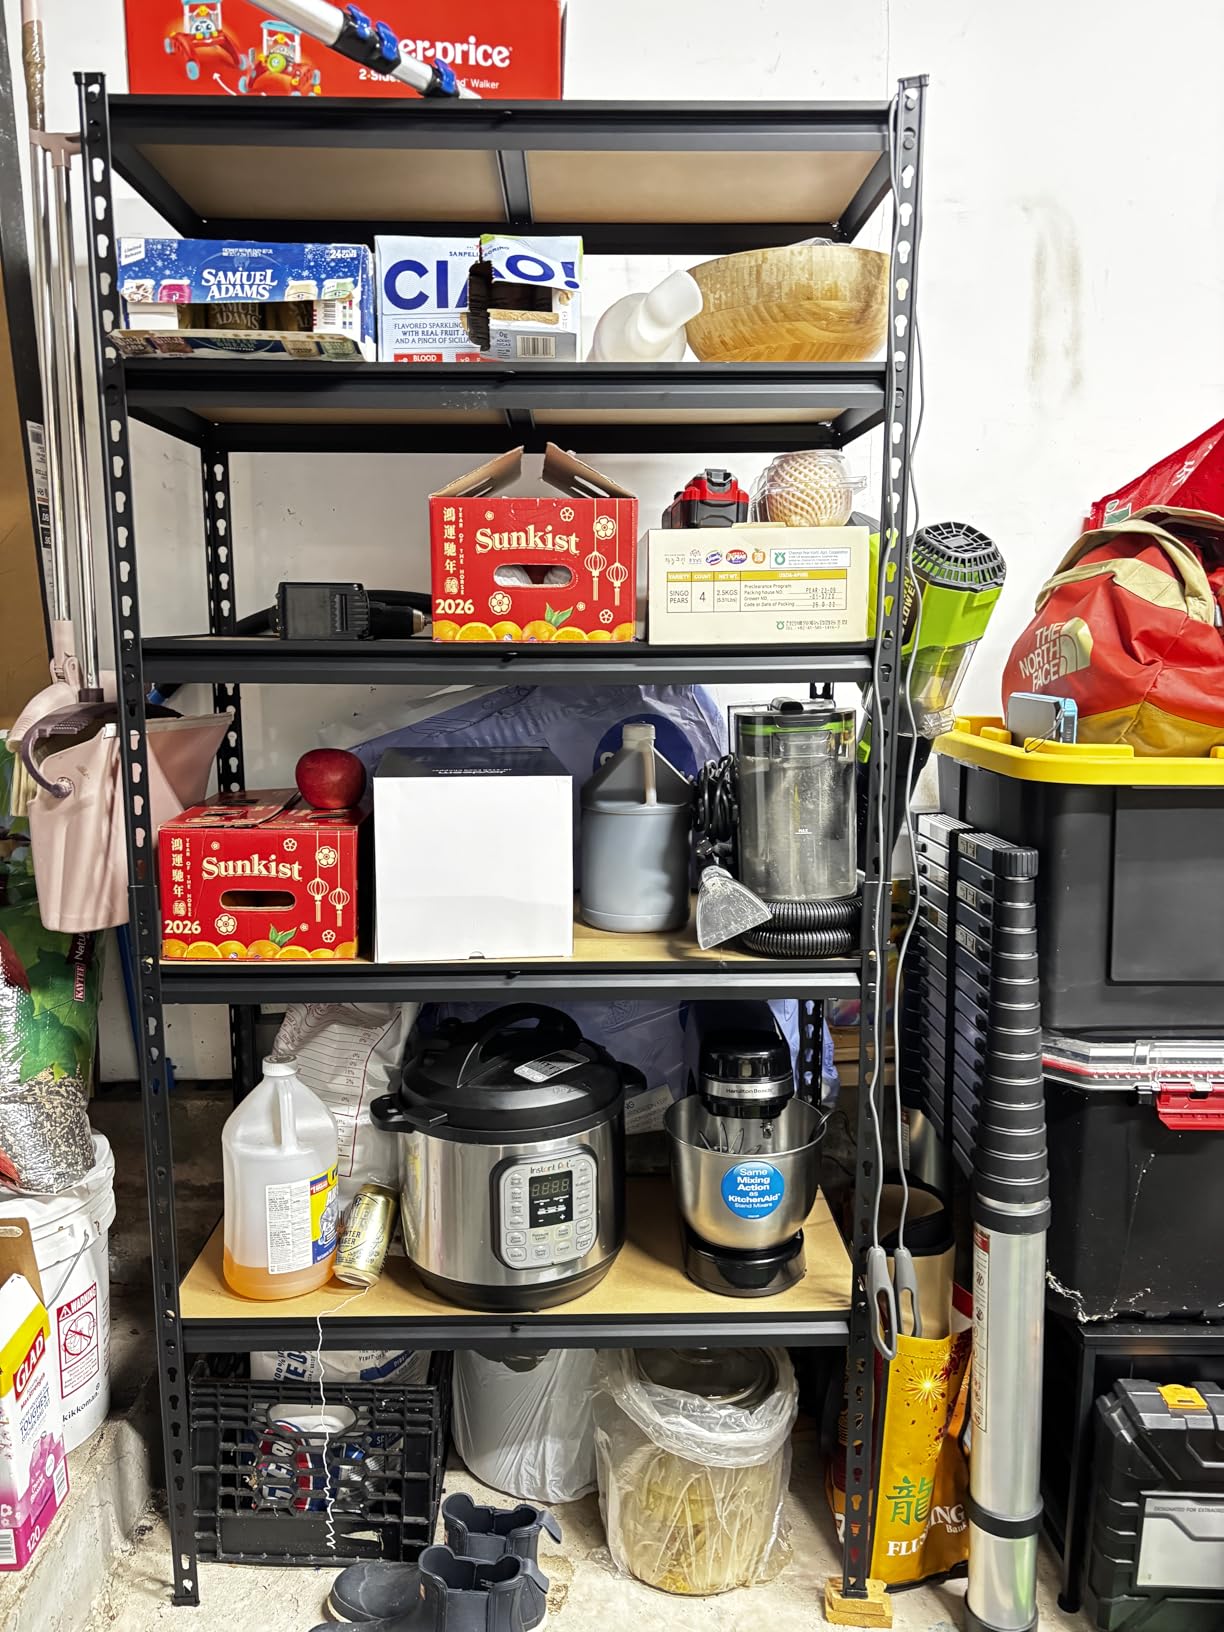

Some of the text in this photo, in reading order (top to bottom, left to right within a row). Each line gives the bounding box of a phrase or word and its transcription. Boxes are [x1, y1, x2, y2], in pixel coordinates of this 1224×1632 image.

[398, 35, 511, 68] er-price
[470, 78, 499, 89] Walker
[330, 249, 341, 259] 24
[201, 268, 278, 286] SAMUEL
[206, 284, 271, 300] ADAMS
[216, 311, 261, 330] ADAMS
[393, 322, 428, 330] FLAVORED
[458, 533, 464, 544] OF
[475, 524, 580, 556] Sunkist
[699, 591, 705, 602] 4
[435, 598, 475, 615] 2026
[1035, 622, 1066, 648] THE
[1019, 638, 1060, 679] NORTH
[1032, 658, 1059, 693] FACE
[202, 854, 303, 881] Sunkist
[164, 919, 201, 934] 2026
[74, 931, 87, 999] KAYTEE Natu
[530, 1161, 571, 1174] Instant Pot
[739, 1168, 768, 1176] Same
[737, 1176, 771, 1184] Mixing
[728, 1194, 779, 1203] KitchenAid
[70, 1285, 97, 1315] WARNING
[15, 1334, 45, 1394] GLAD
[19, 1387, 51, 1437] TOUGHEST
[62, 1391, 99, 1423] kikkoman
[885, 1475, 933, 1525] 龍
[26, 1525, 41, 1553] 120
